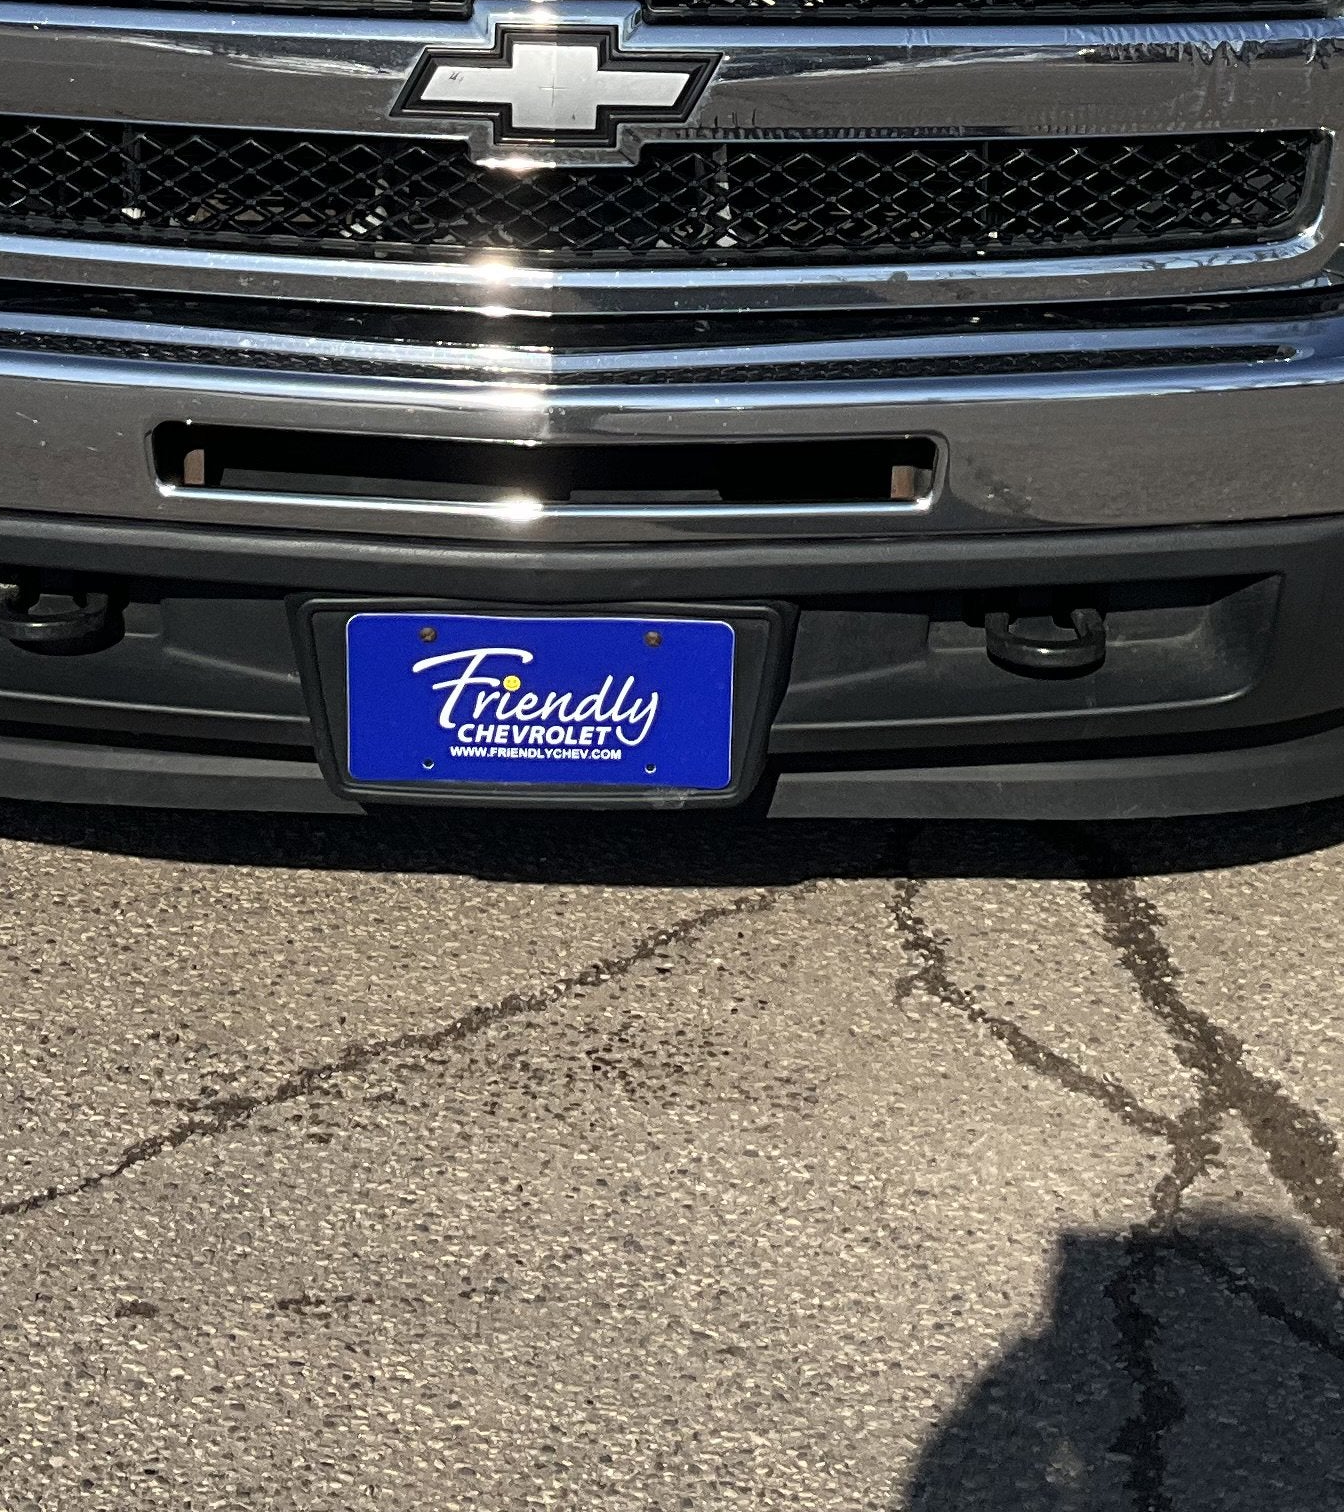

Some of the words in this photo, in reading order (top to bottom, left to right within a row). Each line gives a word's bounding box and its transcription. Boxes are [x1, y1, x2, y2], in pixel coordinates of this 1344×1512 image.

[412, 647, 659, 746] Friendly
[457, 723, 612, 745] CHEVROLET
[450, 745, 622, 760] WWW.FRIENDLYCHEV.COM
